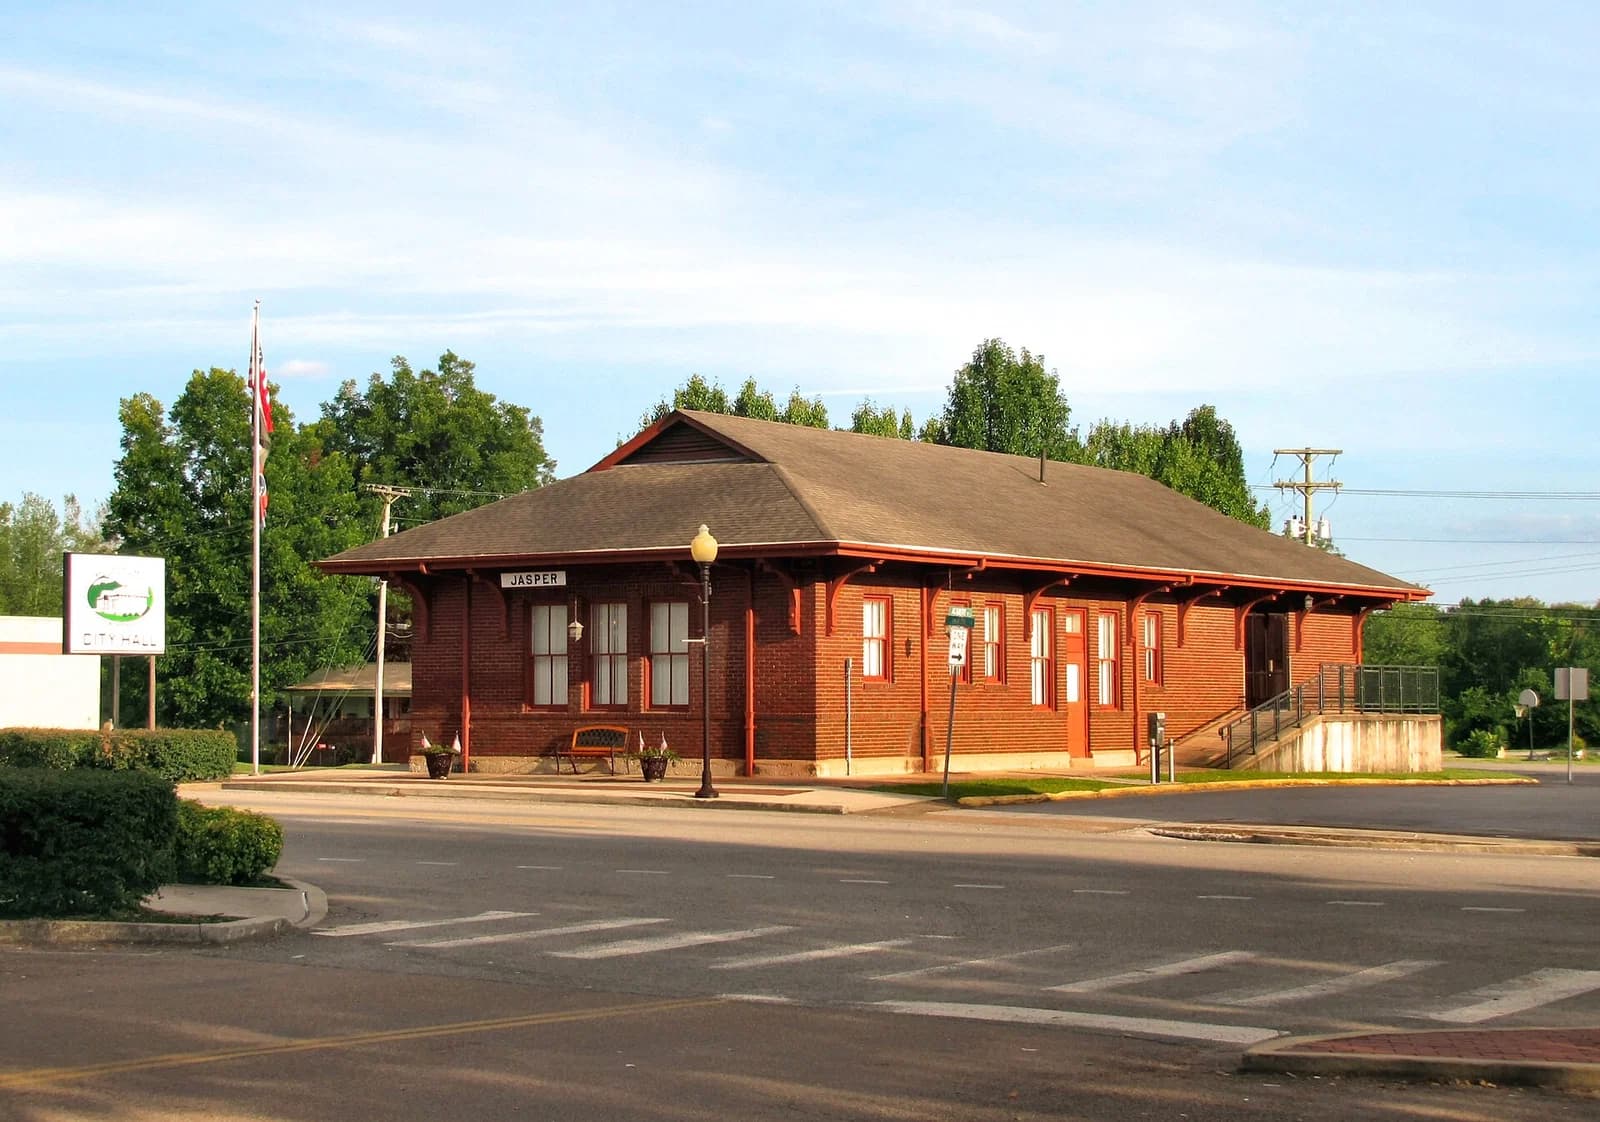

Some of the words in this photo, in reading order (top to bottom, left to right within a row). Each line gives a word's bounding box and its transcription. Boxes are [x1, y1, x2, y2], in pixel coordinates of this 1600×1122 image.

[511, 573, 558, 586] JASPER
[83, 632, 114, 646] CITY
[121, 633, 157, 647] HALL
